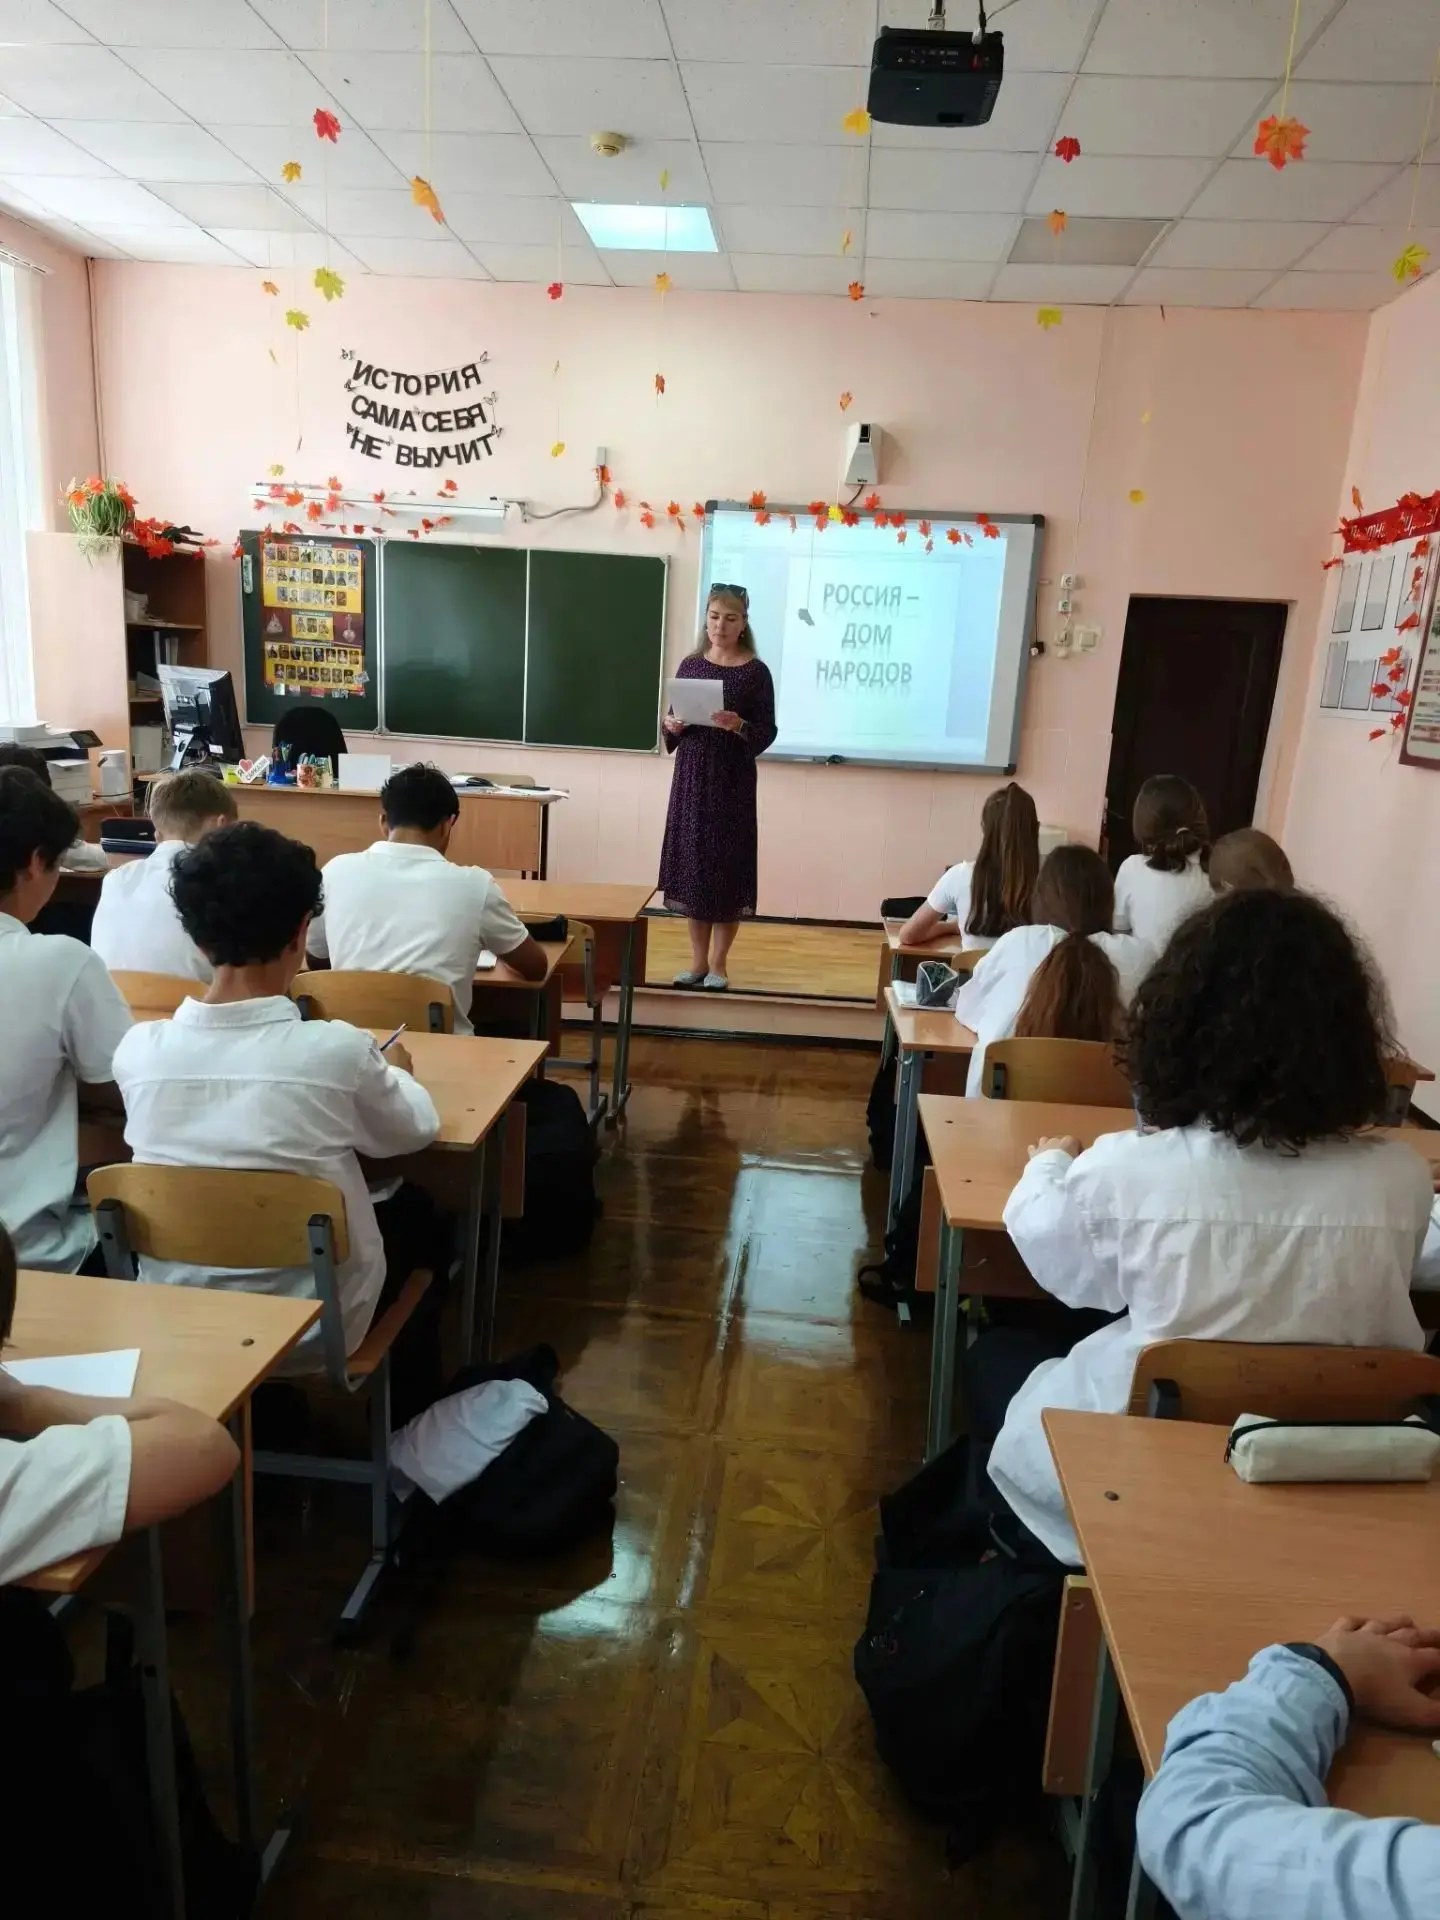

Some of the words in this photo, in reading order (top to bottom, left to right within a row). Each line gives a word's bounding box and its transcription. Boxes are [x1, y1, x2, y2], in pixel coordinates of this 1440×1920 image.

[352, 360, 481, 395] ИСТОРИЯ
[351, 395, 417, 432] САМА
[422, 403, 487, 432] СЕБЯ
[350, 430, 382, 459] НЕ
[395, 433, 493, 468] ВЫУЧИТ
[823, 583, 902, 607] РОССИЯ
[841, 623, 892, 647] ДОМ
[816, 661, 912, 687] НАРОДОВ
